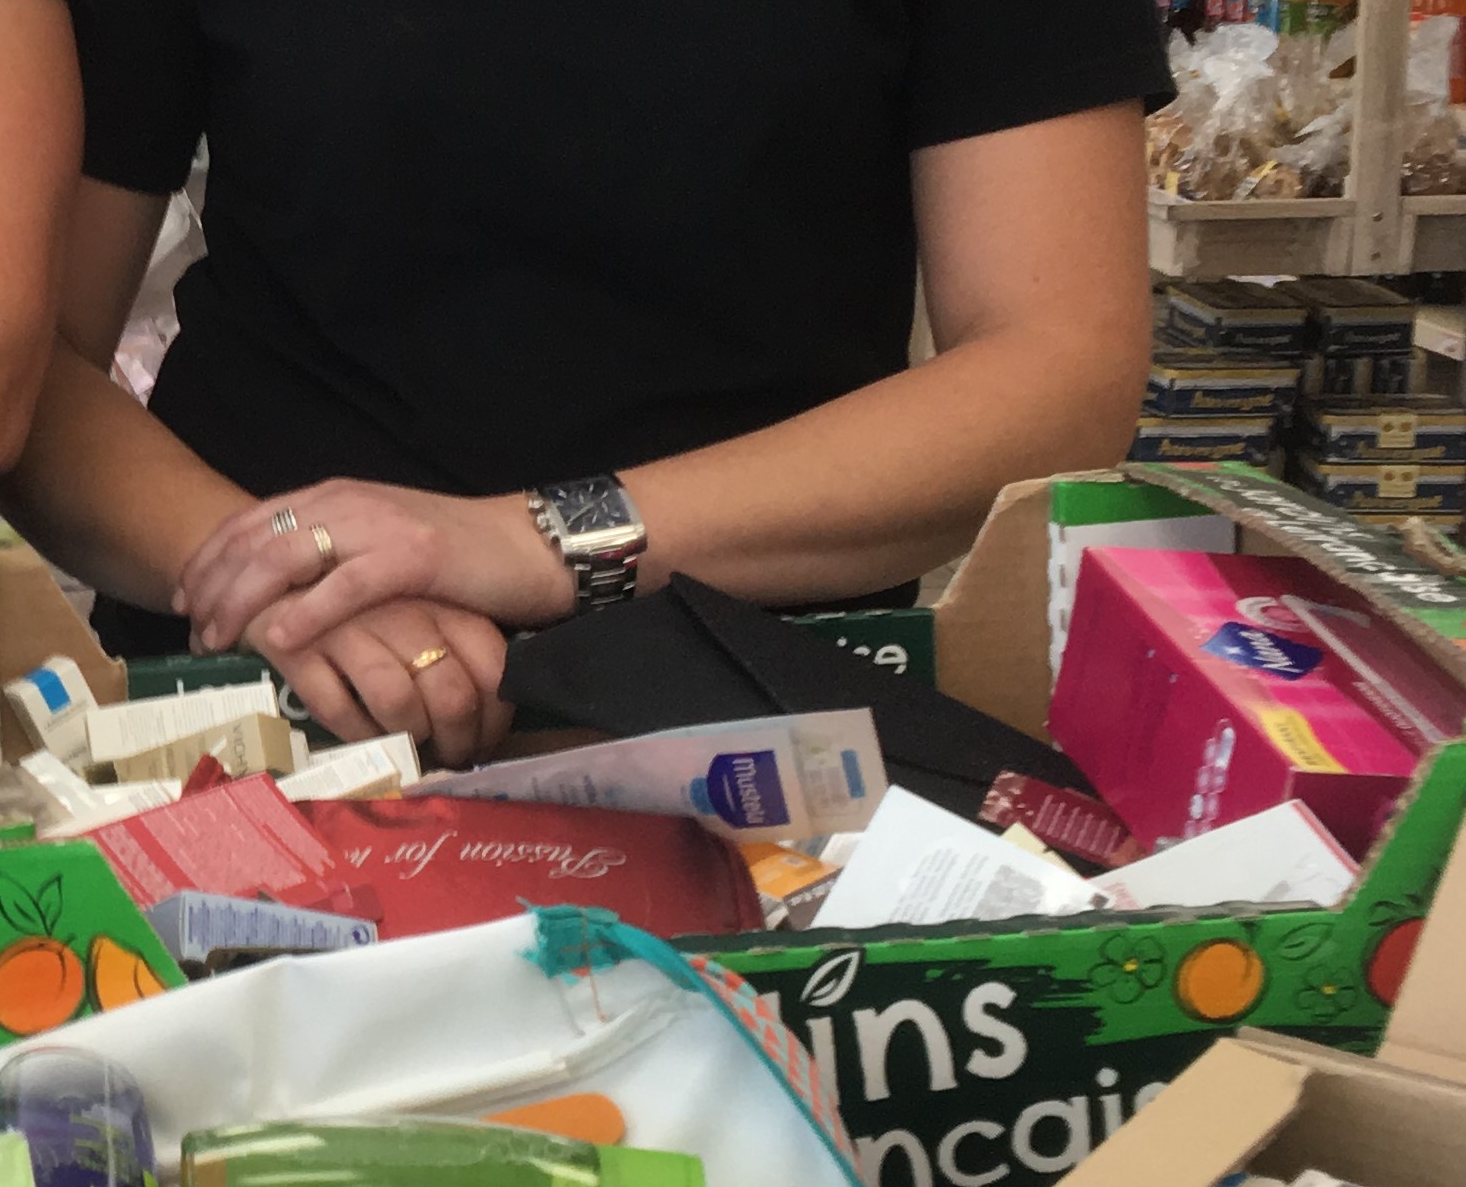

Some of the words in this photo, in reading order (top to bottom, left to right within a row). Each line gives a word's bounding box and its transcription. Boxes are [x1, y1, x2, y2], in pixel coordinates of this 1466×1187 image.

[384, 829, 458, 880] for
[458, 840, 628, 880] Passion
[758, 949, 1029, 1108] ins
[852, 1066, 1170, 1187] ncai
